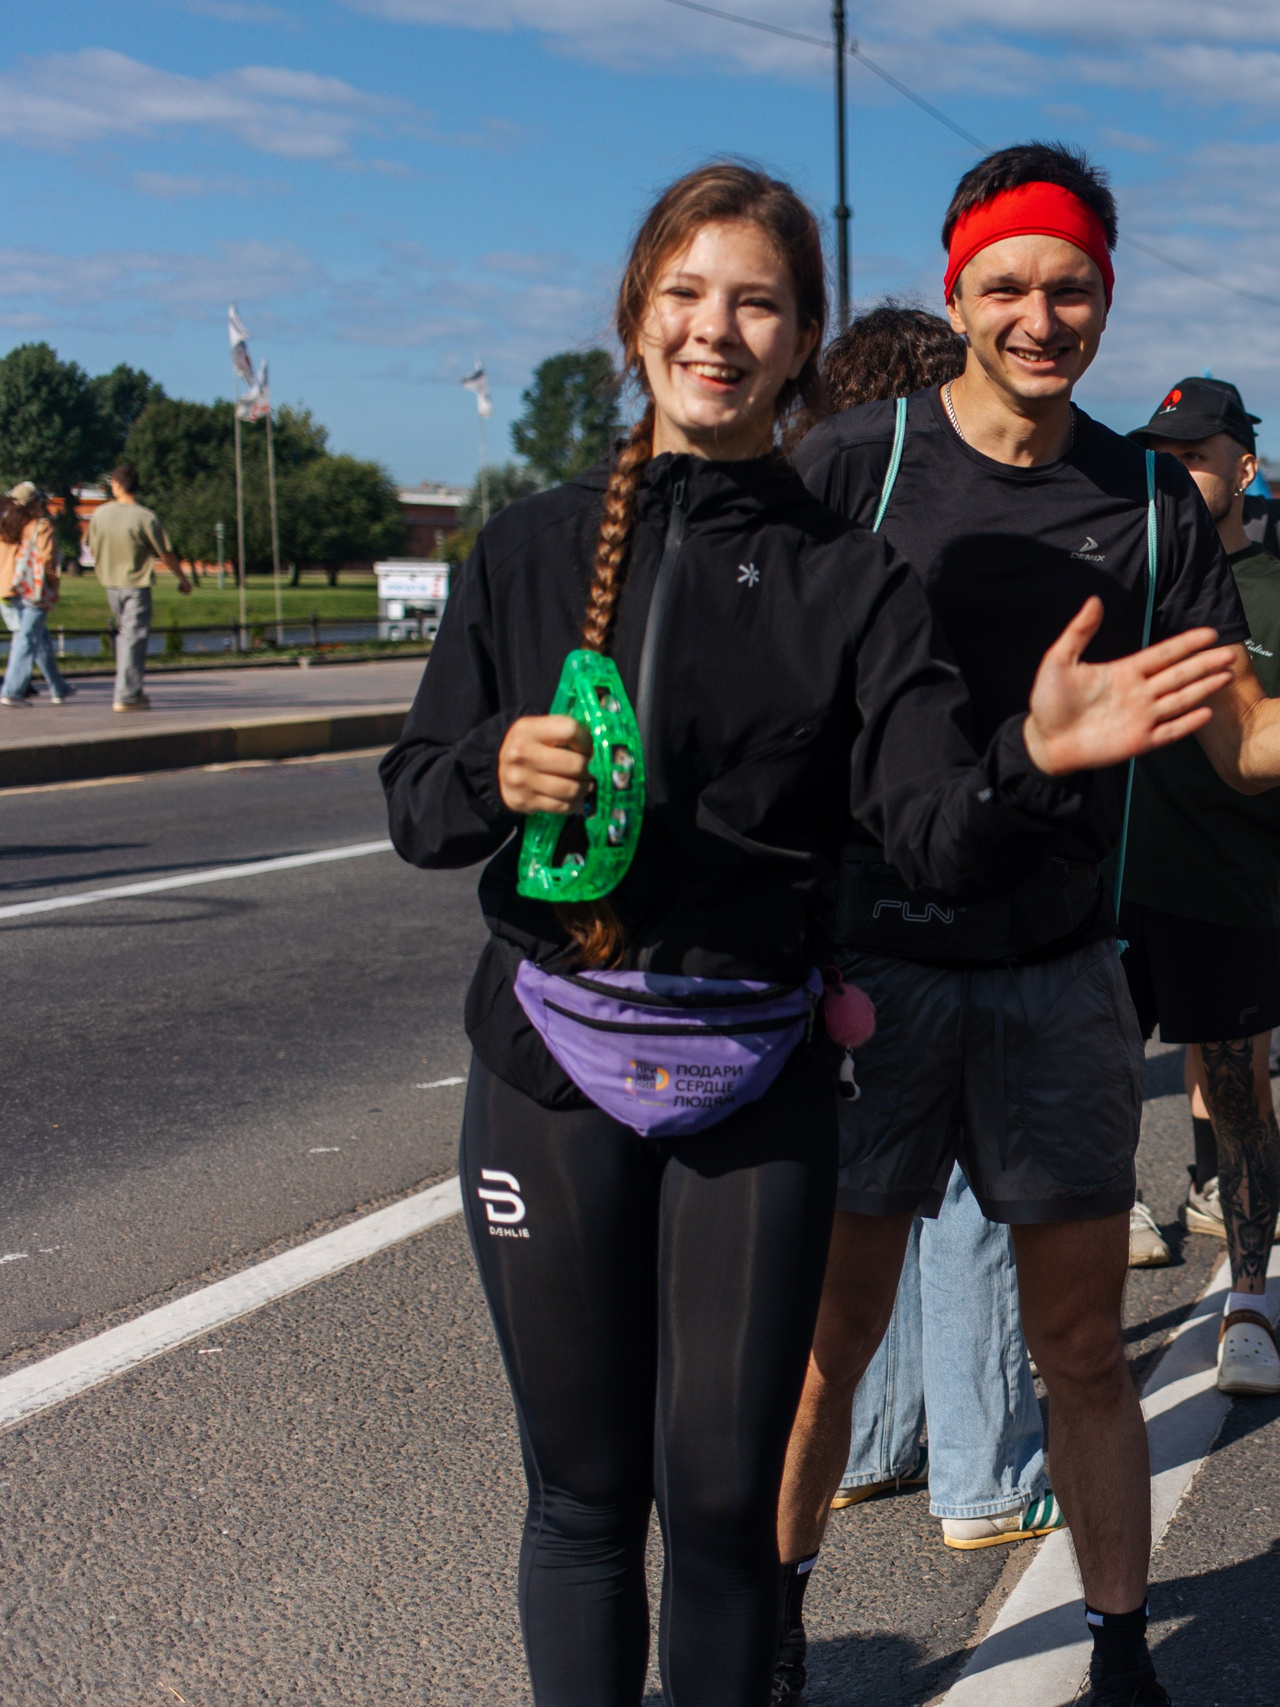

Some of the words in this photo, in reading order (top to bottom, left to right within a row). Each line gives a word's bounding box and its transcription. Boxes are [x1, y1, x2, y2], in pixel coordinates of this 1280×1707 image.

[676, 1064, 743, 1078] ПОДАРИ
[675, 1079, 735, 1093] СЕРДЦЕ
[673, 1095, 736, 1108] ЛЮДЯМ
